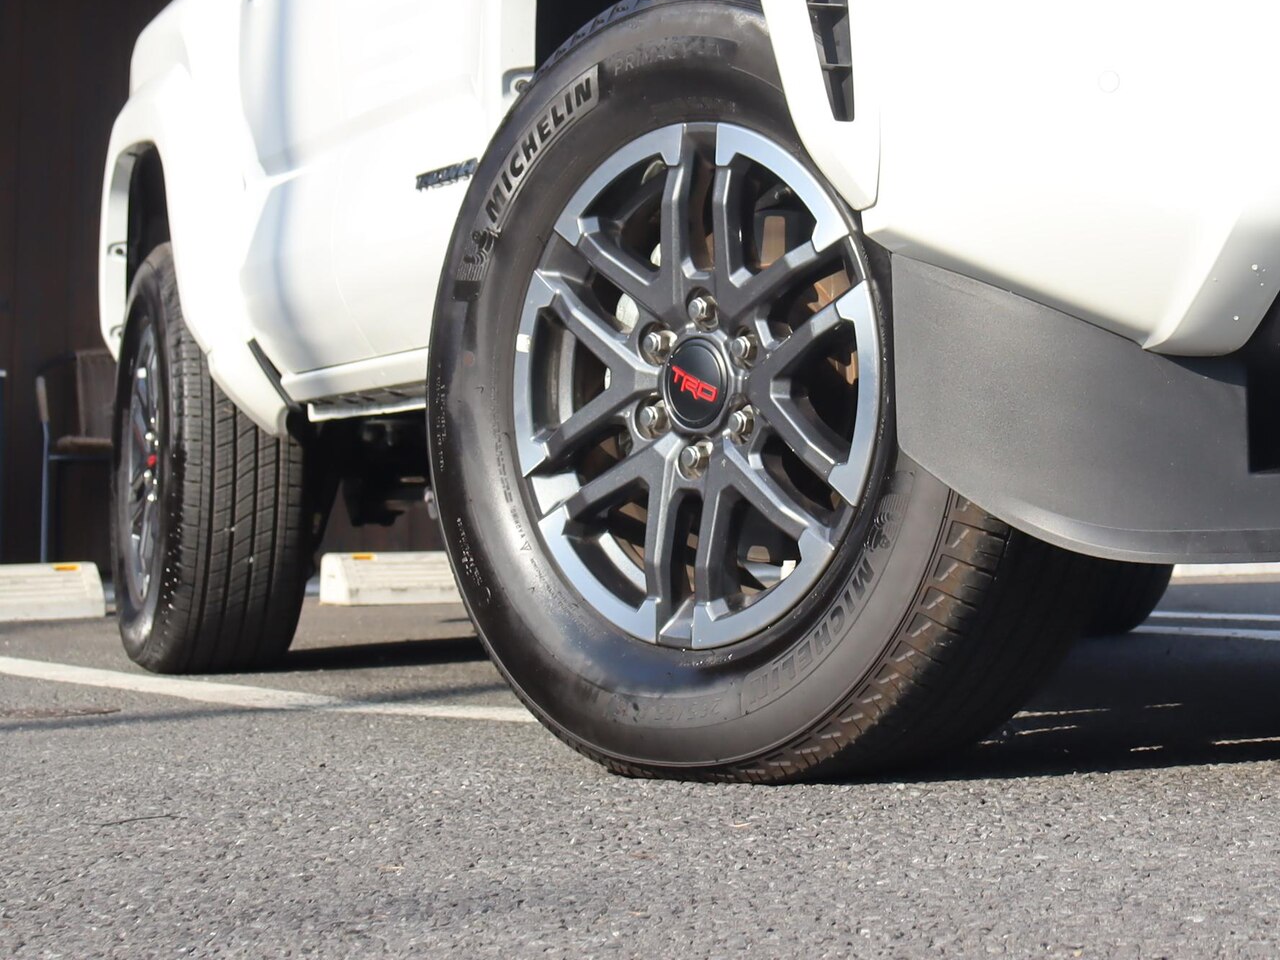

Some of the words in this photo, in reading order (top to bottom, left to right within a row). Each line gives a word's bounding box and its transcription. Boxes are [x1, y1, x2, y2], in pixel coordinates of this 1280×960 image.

[484, 75, 592, 223] MICHELIN
[671, 365, 718, 403] TRD
[749, 556, 876, 707] MICHELIN
